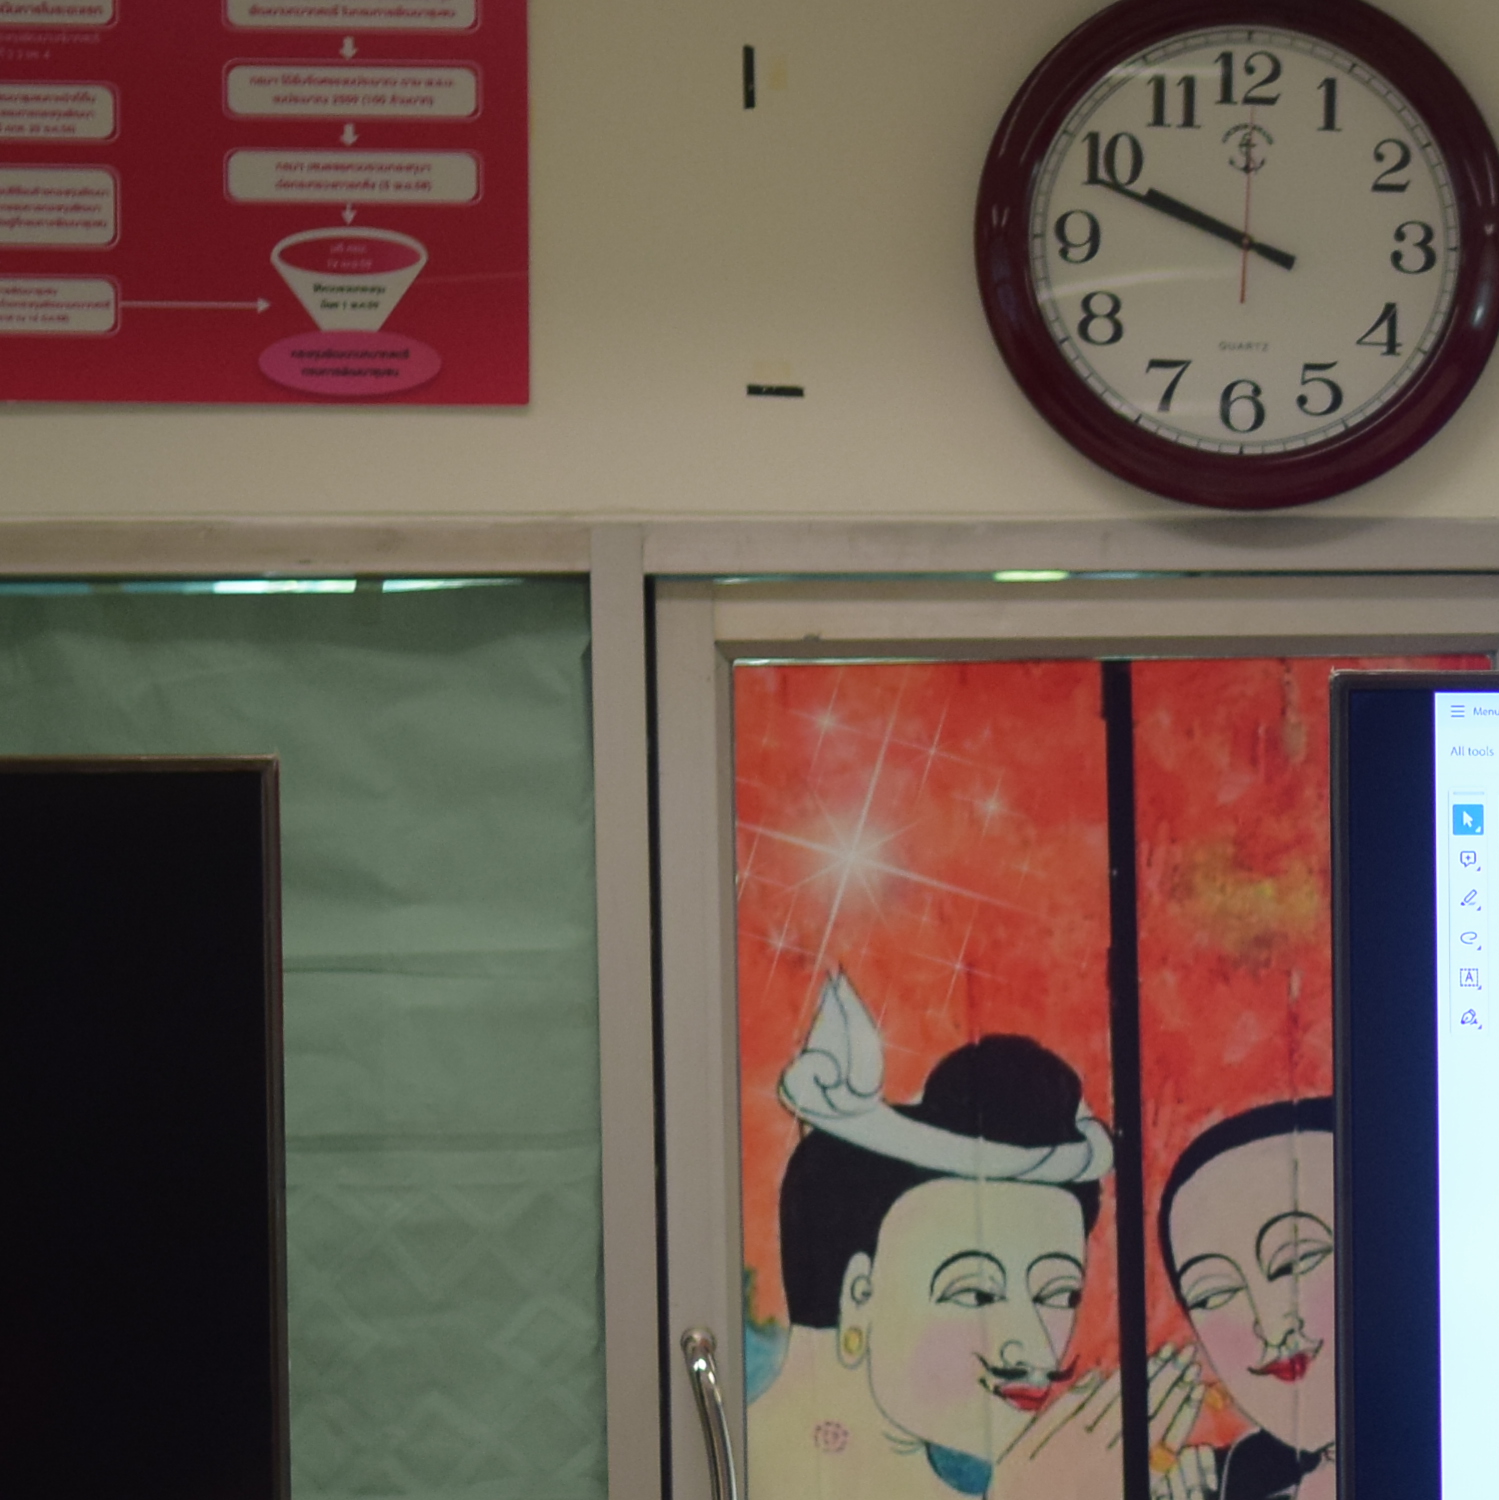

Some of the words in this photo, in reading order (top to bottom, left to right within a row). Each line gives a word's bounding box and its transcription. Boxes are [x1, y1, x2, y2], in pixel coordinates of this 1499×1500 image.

[1147, 75, 1201, 128] 11
[1215, 51, 1281, 106] 12
[1316, 78, 1341, 132] 1
[1082, 131, 1143, 187] 10
[1371, 139, 1411, 192] 2
[1055, 210, 1102, 264] 9
[1390, 221, 1436, 273] 3
[1078, 292, 1124, 345] 8
[1356, 303, 1403, 357] 4
[1217, 340, 1269, 352] QUARTZ
[1145, 360, 1191, 411] 7
[1220, 379, 1265, 433] 6
[1297, 362, 1343, 416] 5
[1472, 706, 1499, 715] Menu
[1450, 745, 1467, 756] All
[1467, 745, 1494, 756] tools
